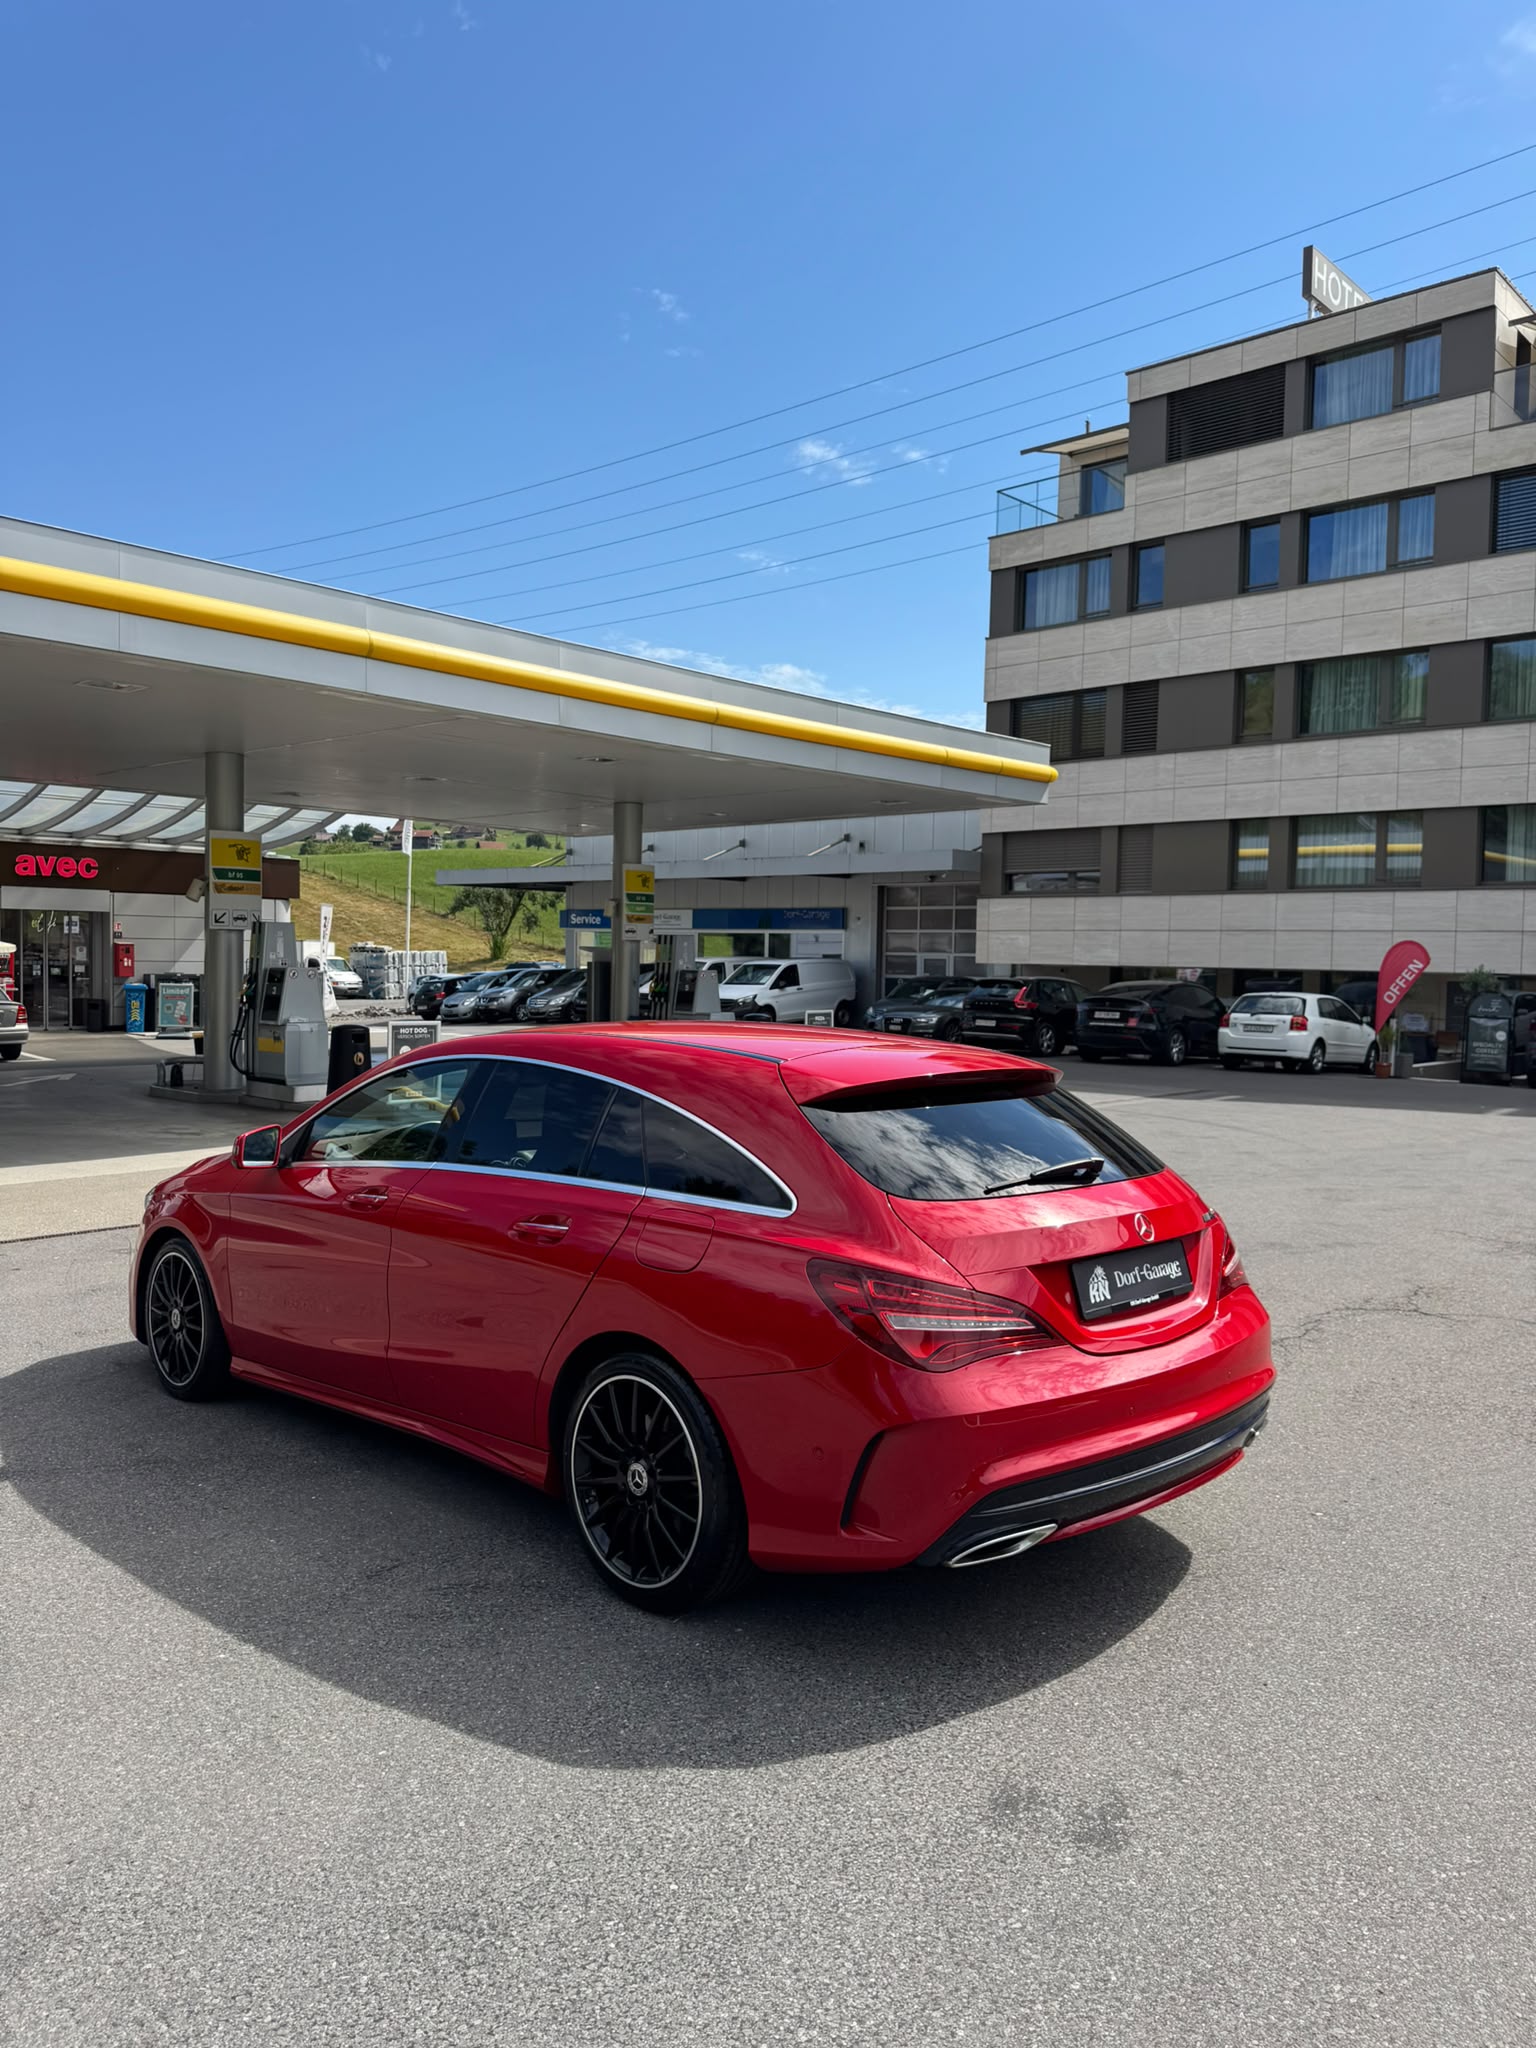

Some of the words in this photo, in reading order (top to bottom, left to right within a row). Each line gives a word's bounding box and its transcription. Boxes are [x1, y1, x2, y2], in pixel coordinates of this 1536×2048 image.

[14, 854, 99, 879] avec
[570, 913, 601, 925] Service
[1383, 959, 1424, 1004] OFFEN
[1114, 1260, 1182, 1288] Dorf-Garage
[1089, 1281, 1111, 1304] KN
